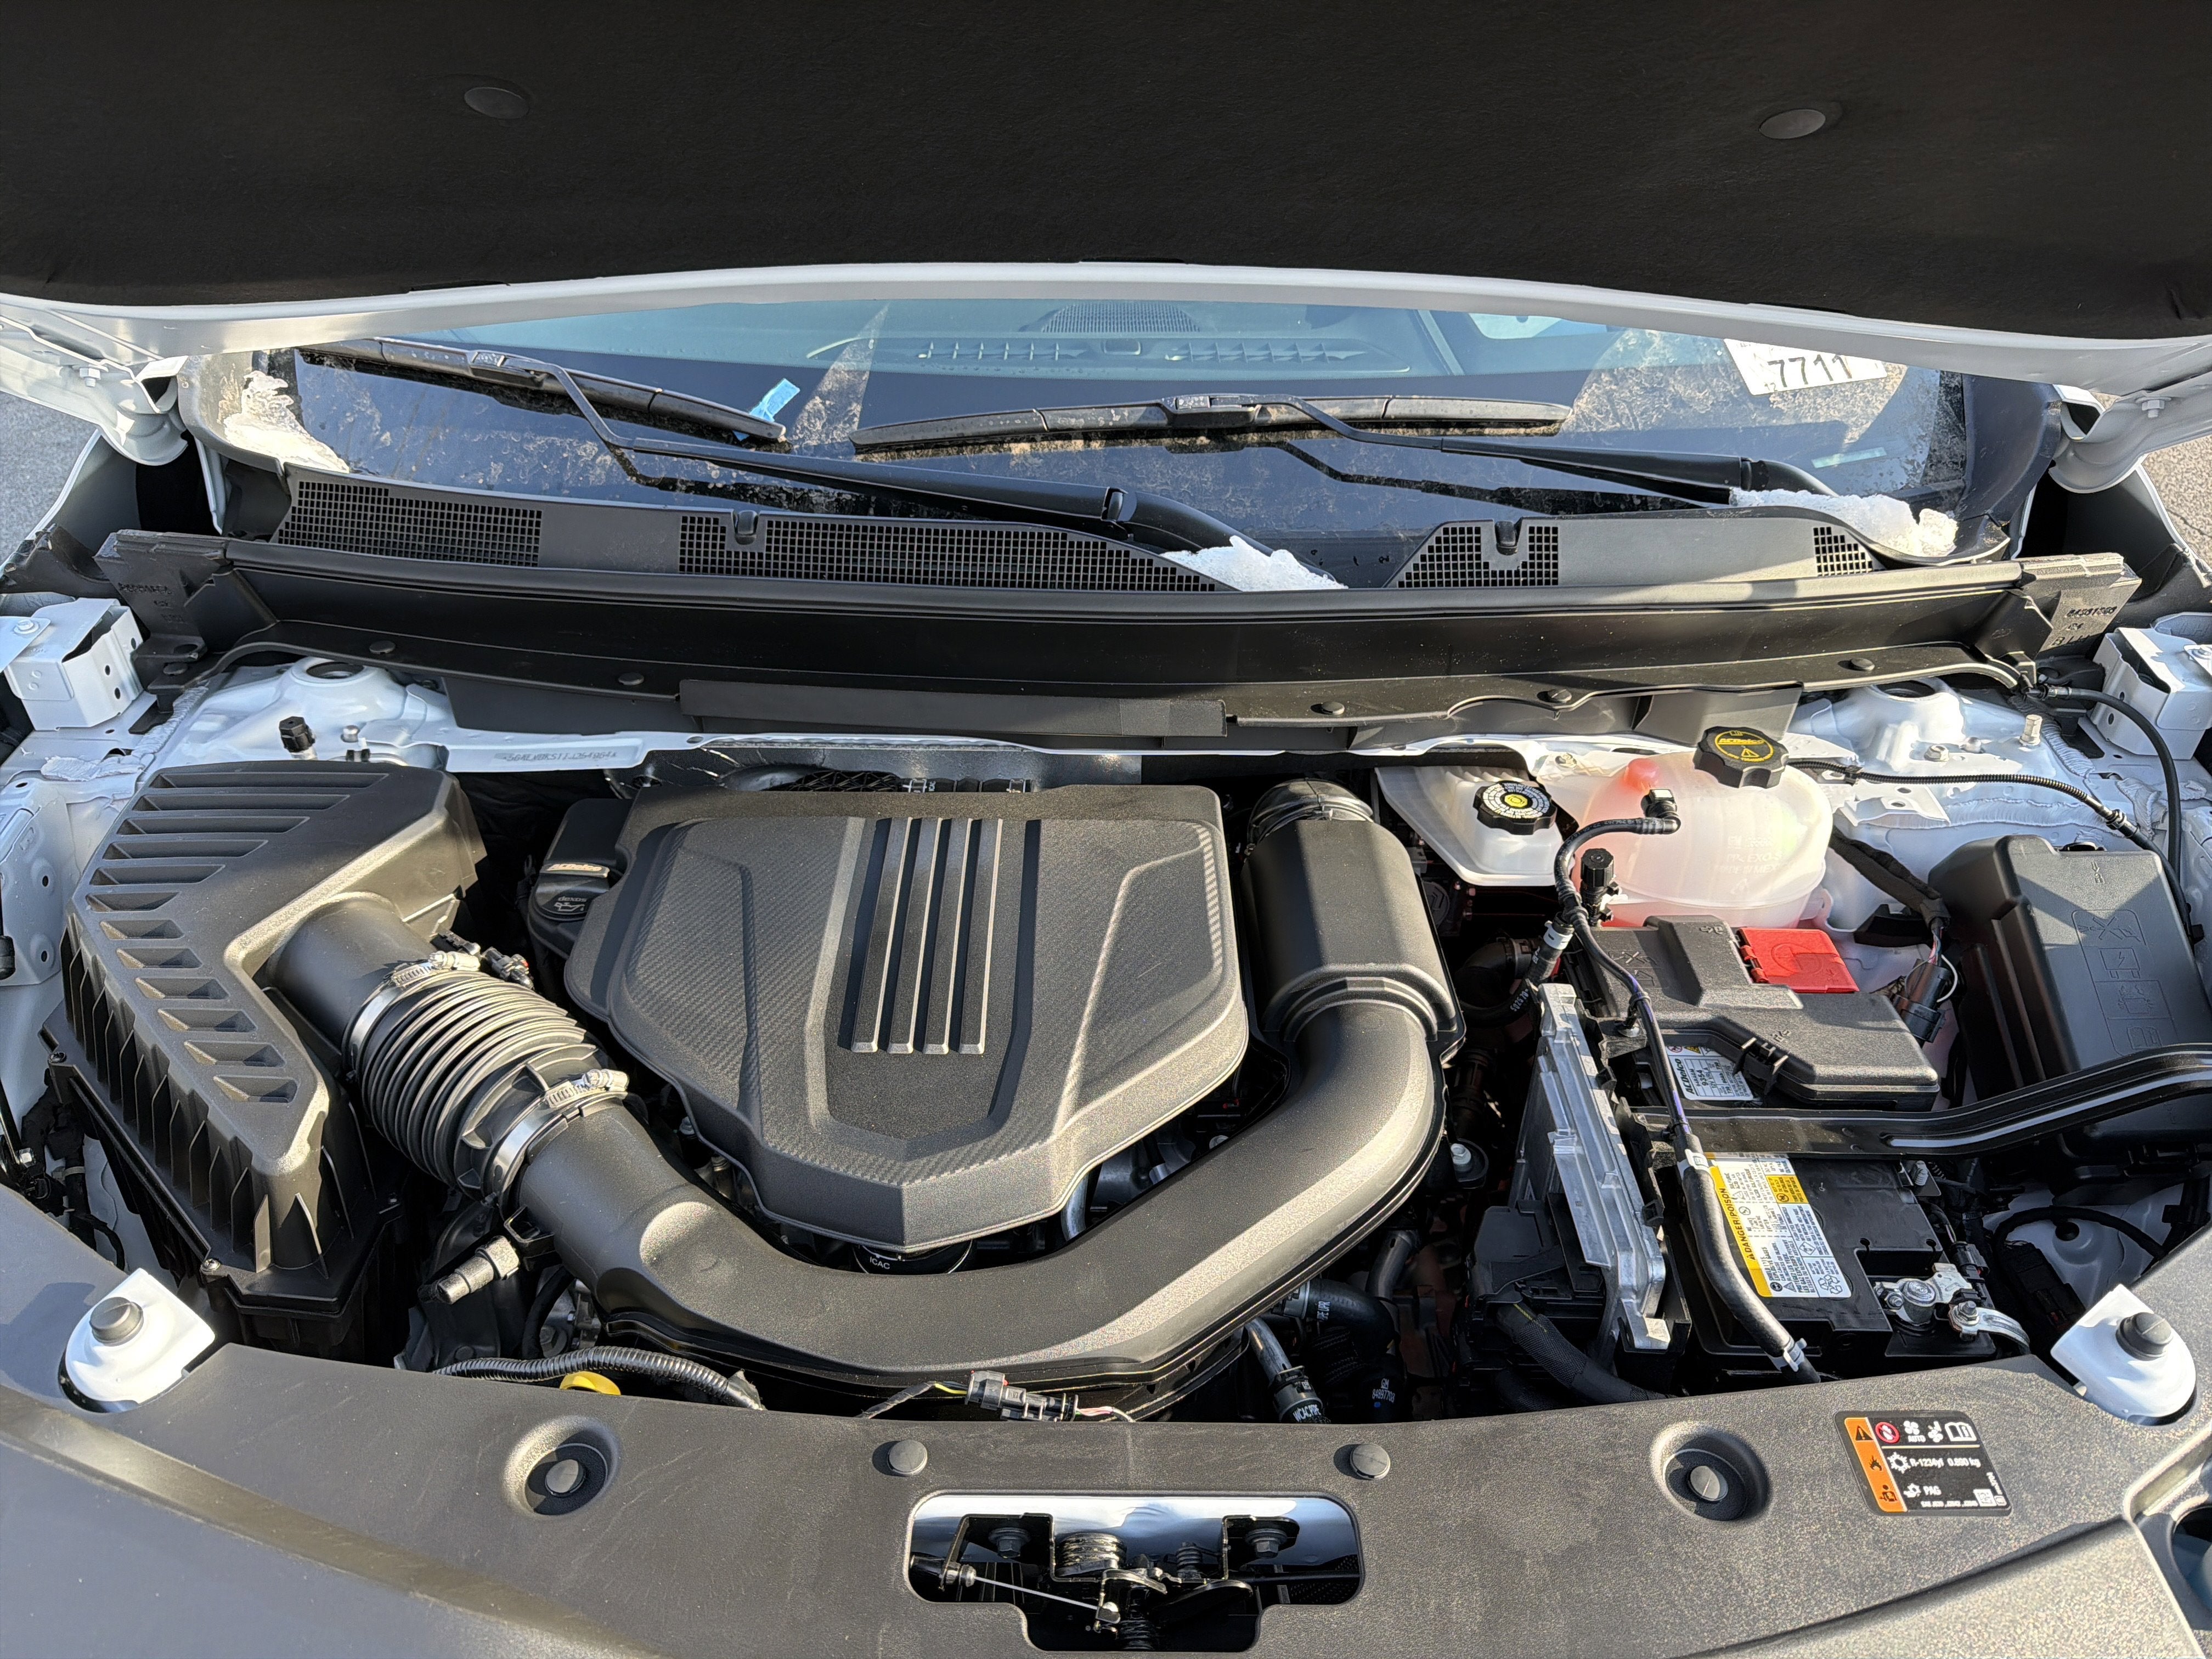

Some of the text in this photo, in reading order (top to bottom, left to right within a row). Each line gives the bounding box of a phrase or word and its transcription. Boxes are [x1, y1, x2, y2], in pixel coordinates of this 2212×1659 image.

[1767, 354, 1853, 387] 7711
[1674, 1058, 1694, 1094] ACDelco
[1696, 1069, 1708, 1086] 9354
[1720, 1188, 1751, 1252] DANGER/POISON
[870, 1256, 890, 1269] ICAC
[1381, 1378, 1390, 1389] GM
[1909, 1458, 1944, 1468] R-1234yf
[1968, 1457, 1982, 1468] kg
[1923, 1486, 1942, 1496] PAG
